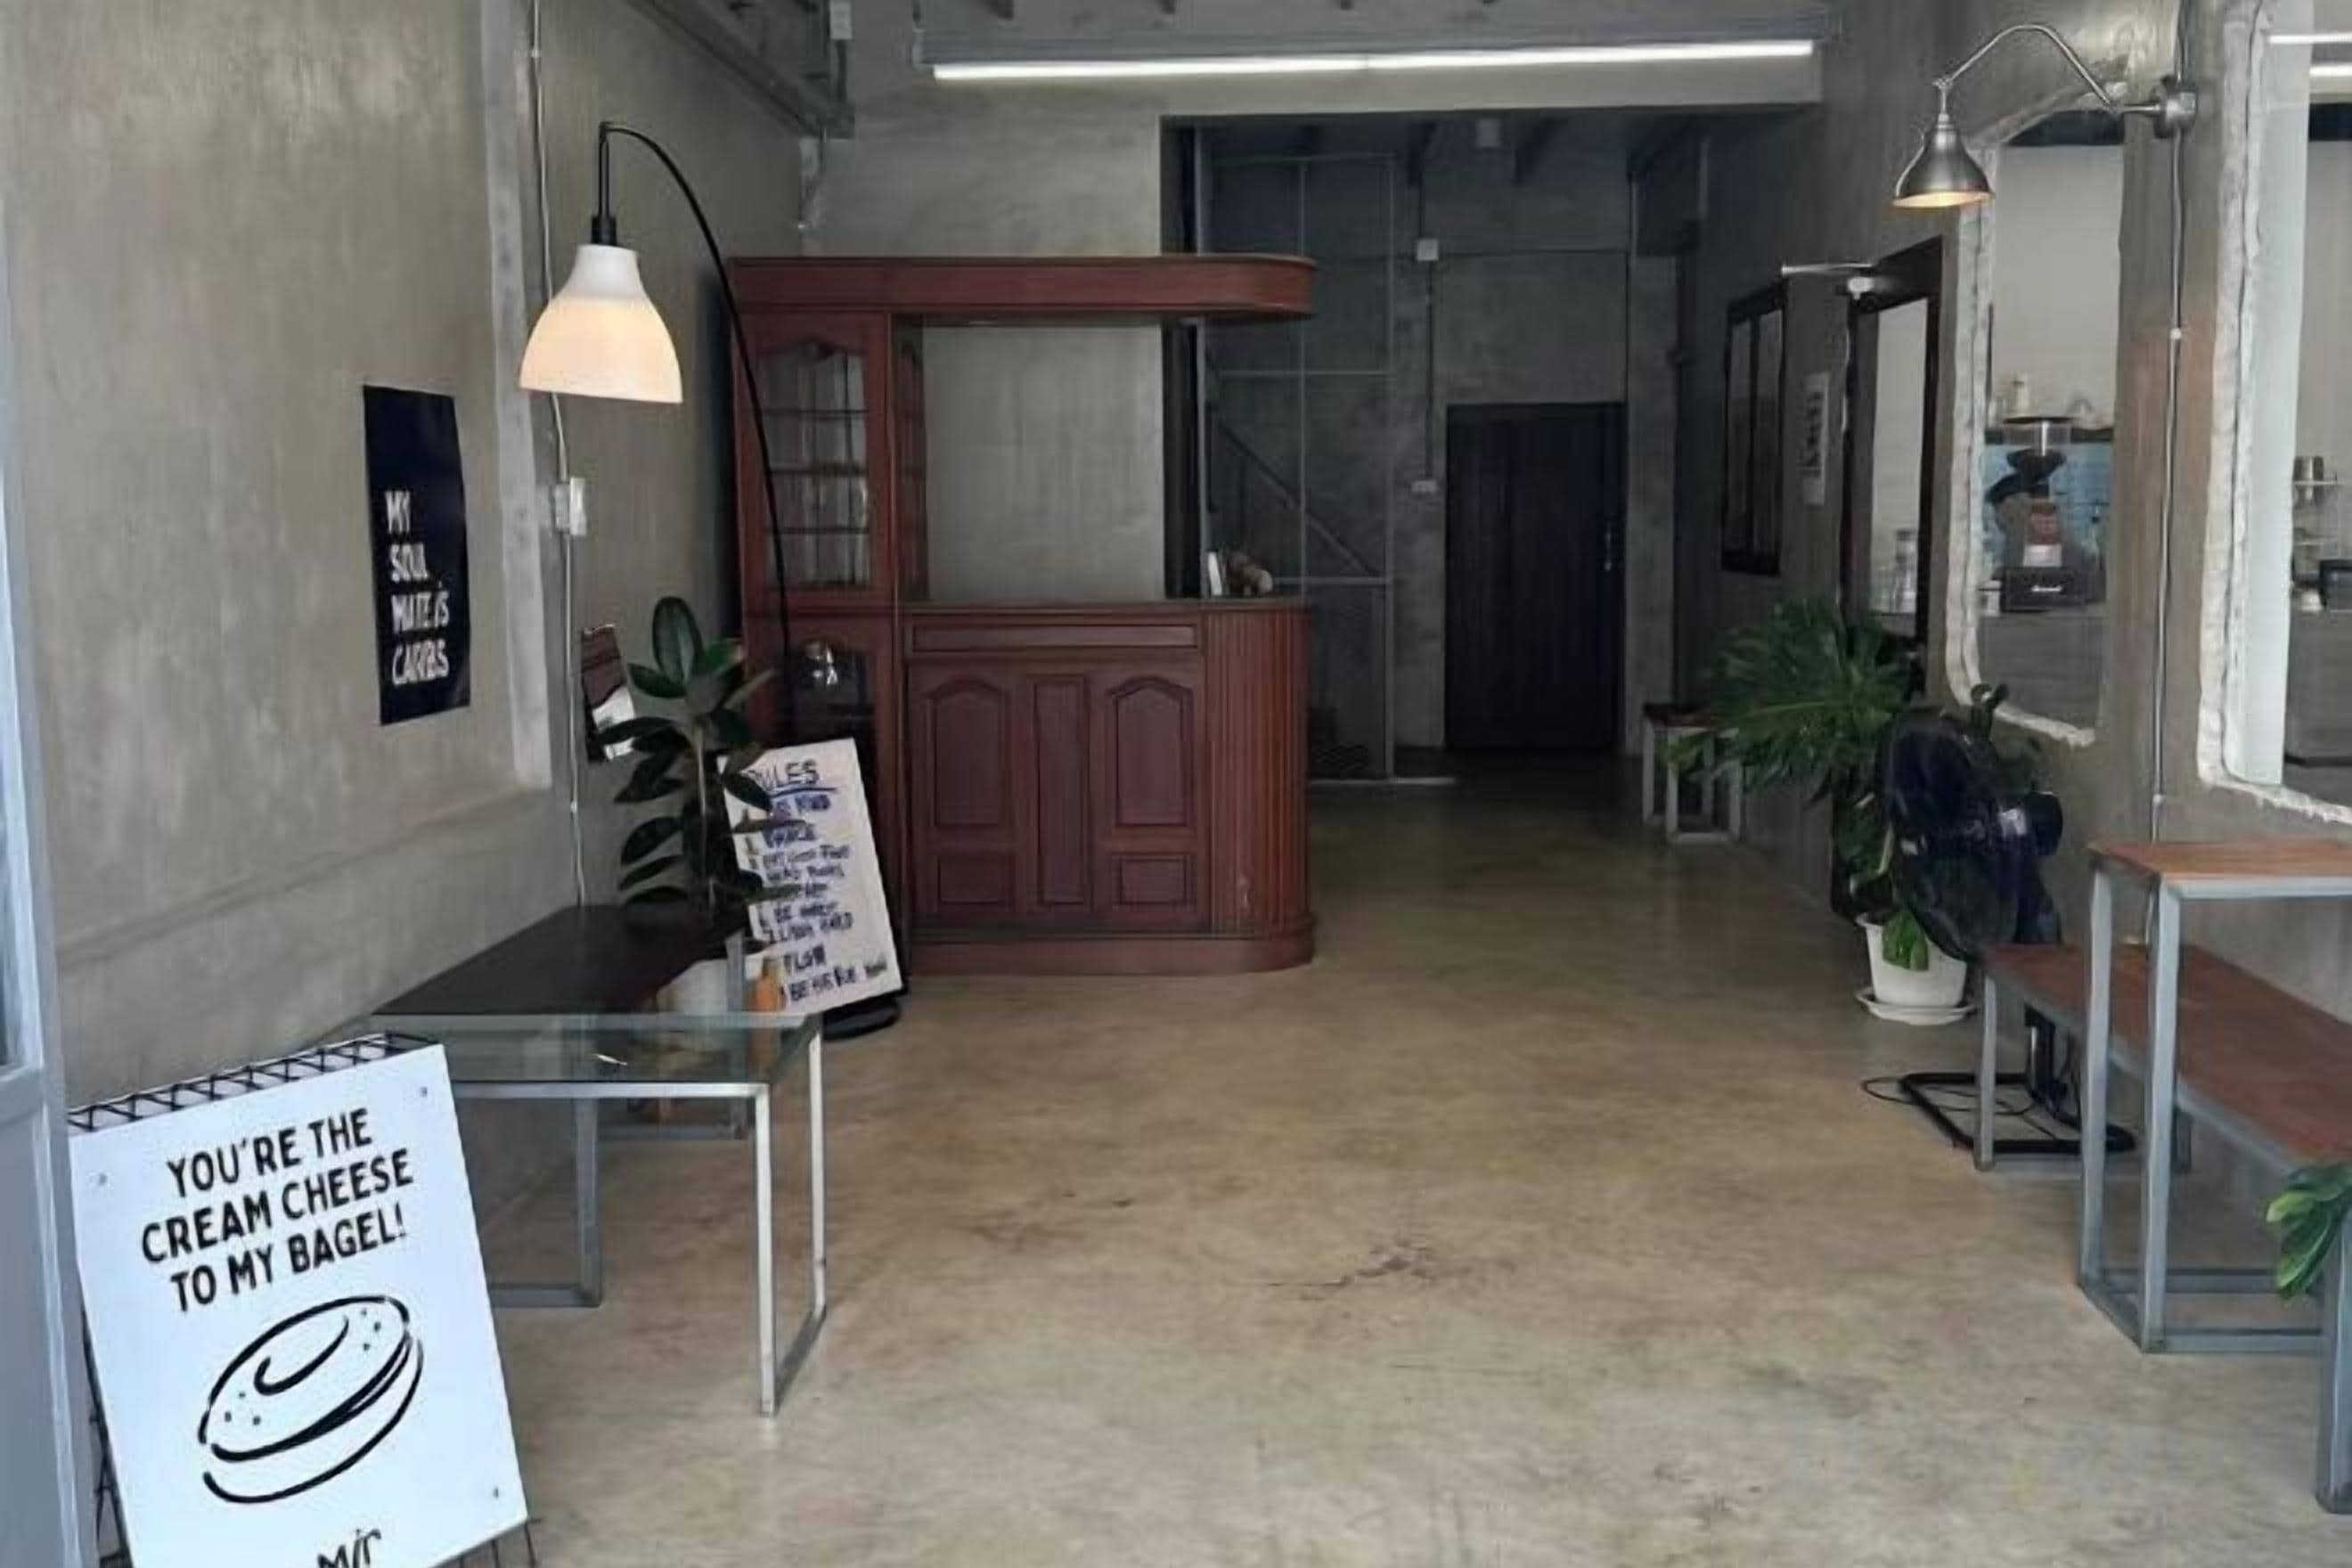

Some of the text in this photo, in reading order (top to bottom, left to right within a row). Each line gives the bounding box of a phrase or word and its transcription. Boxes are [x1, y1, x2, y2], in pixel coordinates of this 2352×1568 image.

[385, 489, 411, 534] MY
[167, 1107, 373, 1198] YOU'RE THE
[141, 1147, 413, 1264] CREAM CHEESE
[170, 1203, 407, 1312] TO MY BAGEL!
